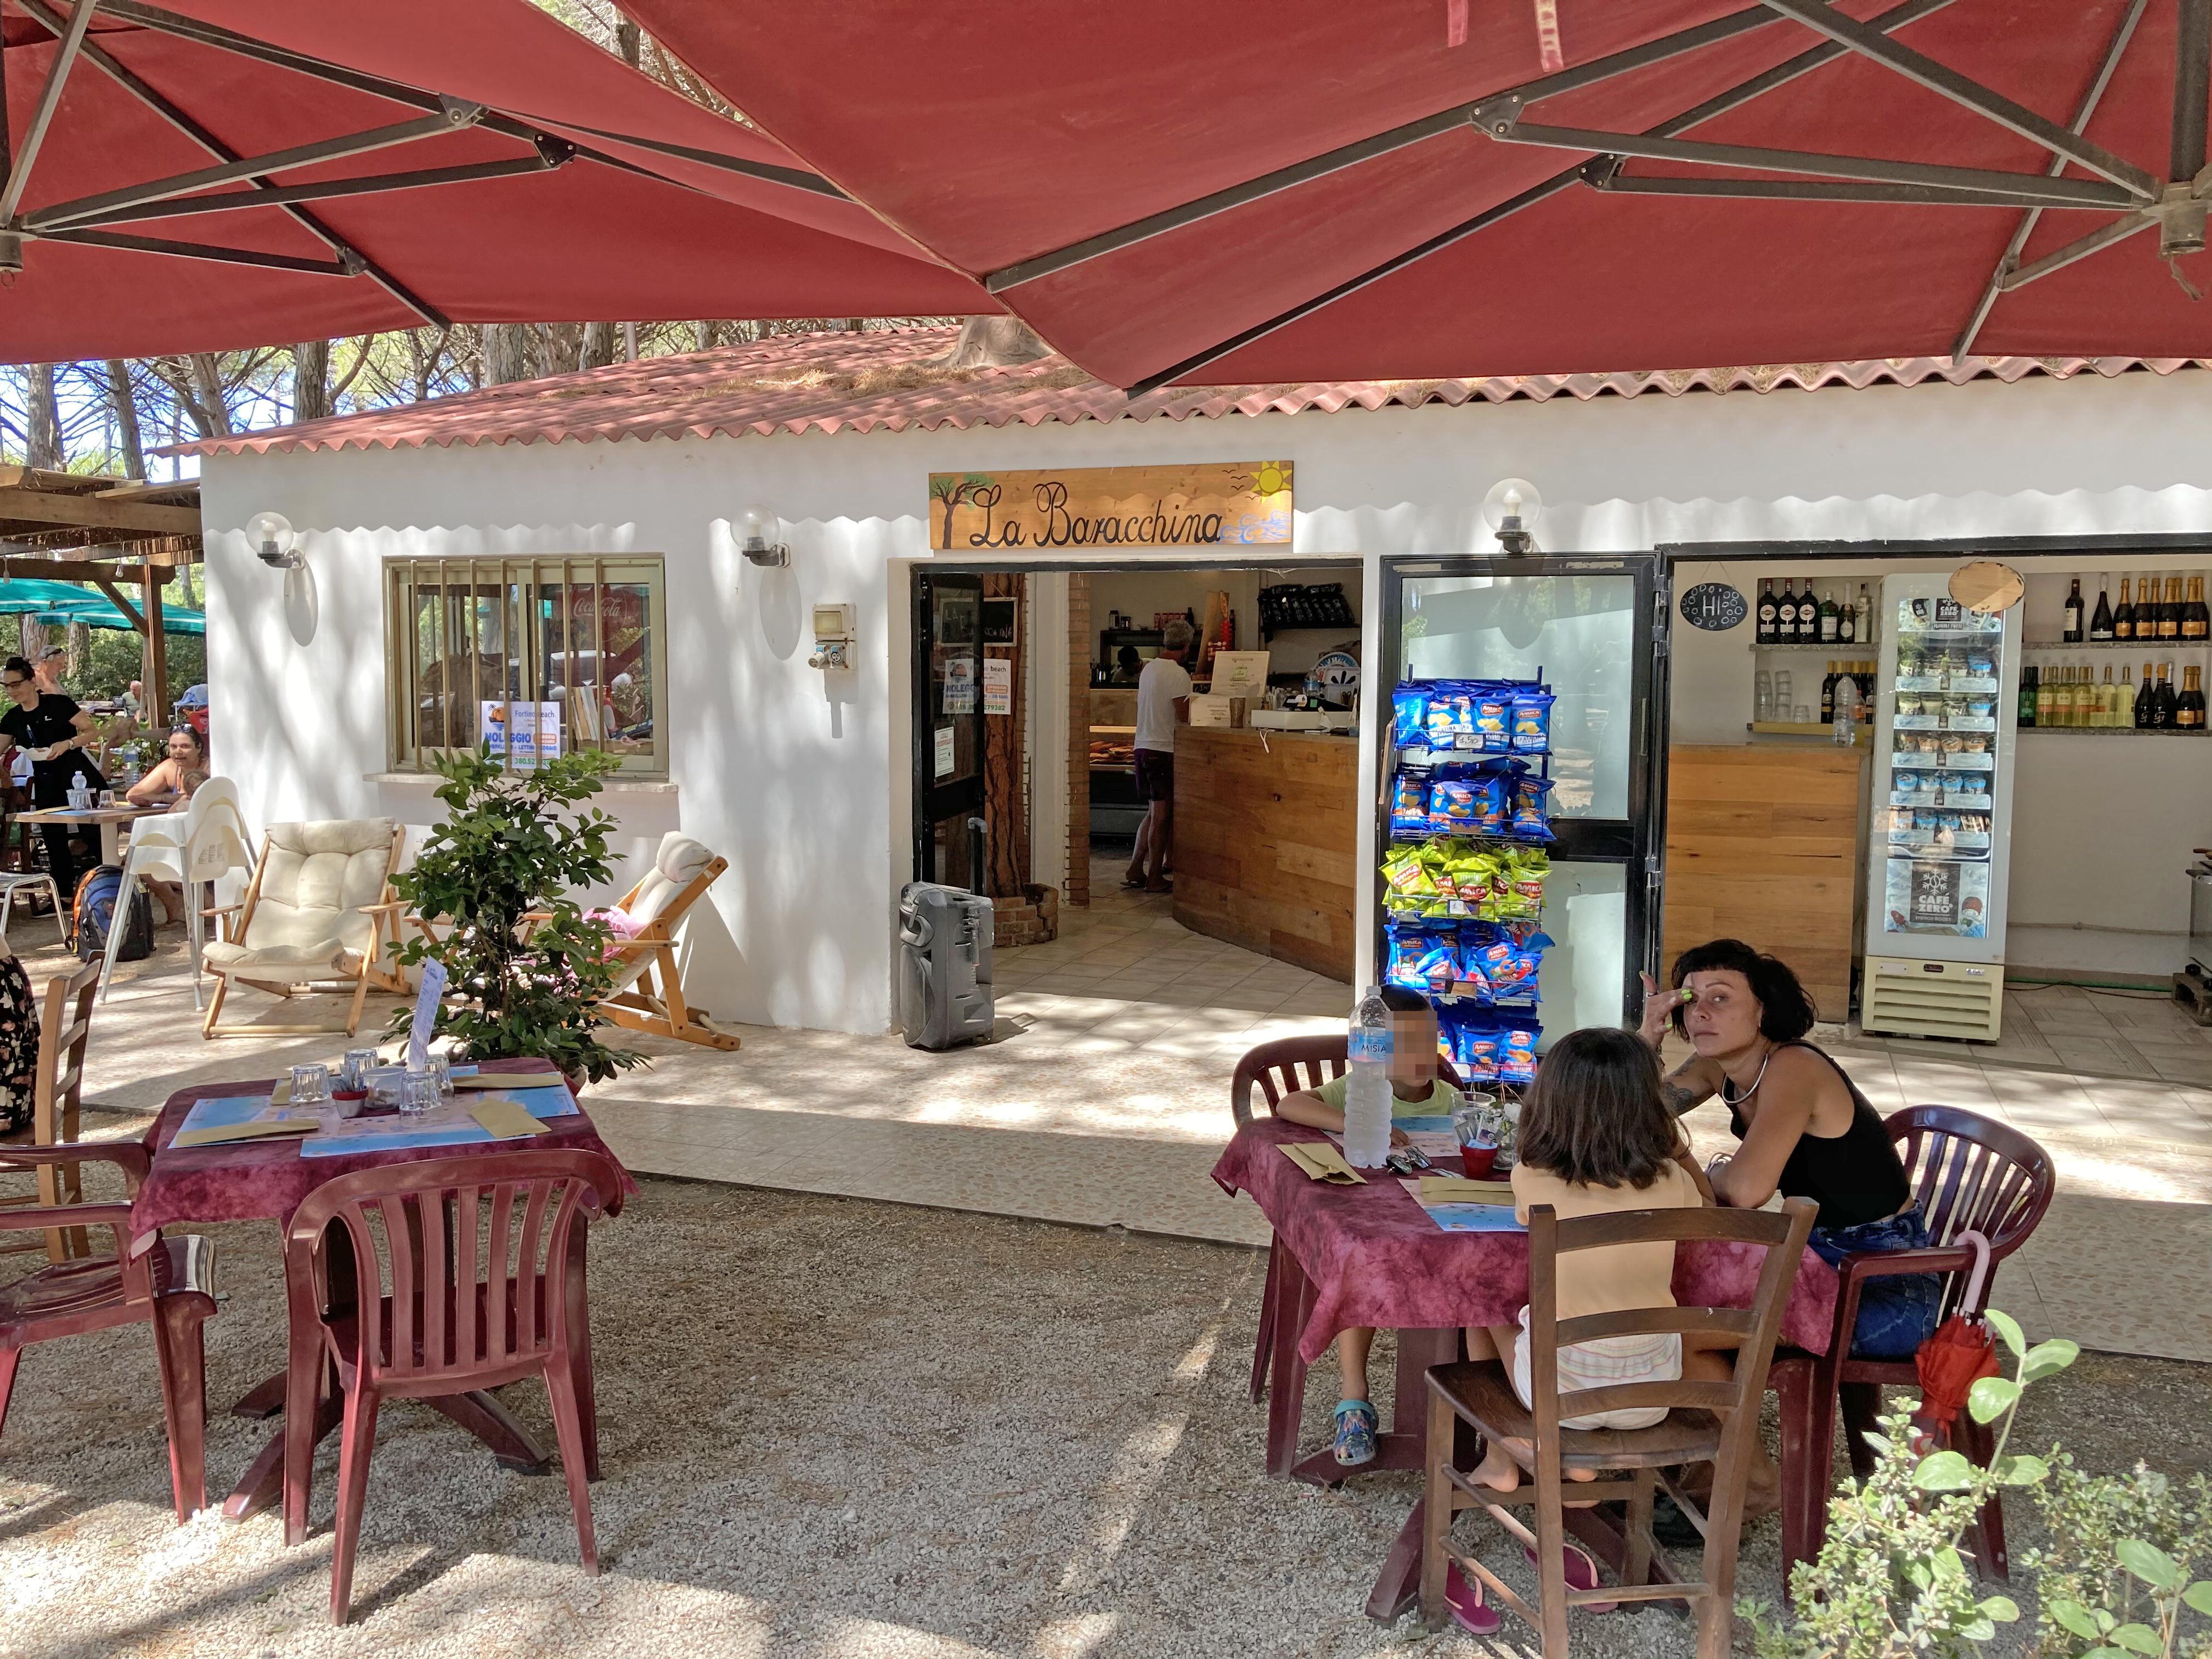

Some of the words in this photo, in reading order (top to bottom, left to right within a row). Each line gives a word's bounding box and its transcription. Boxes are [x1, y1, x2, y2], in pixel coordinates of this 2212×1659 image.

[970, 484, 1027, 548] La
[1032, 482, 1223, 547] Baracchina
[485, 732, 532, 743] NOLGGIO
[1918, 892, 1949, 905] CAFÉ
[1488, 947, 1506, 957] AMICA
